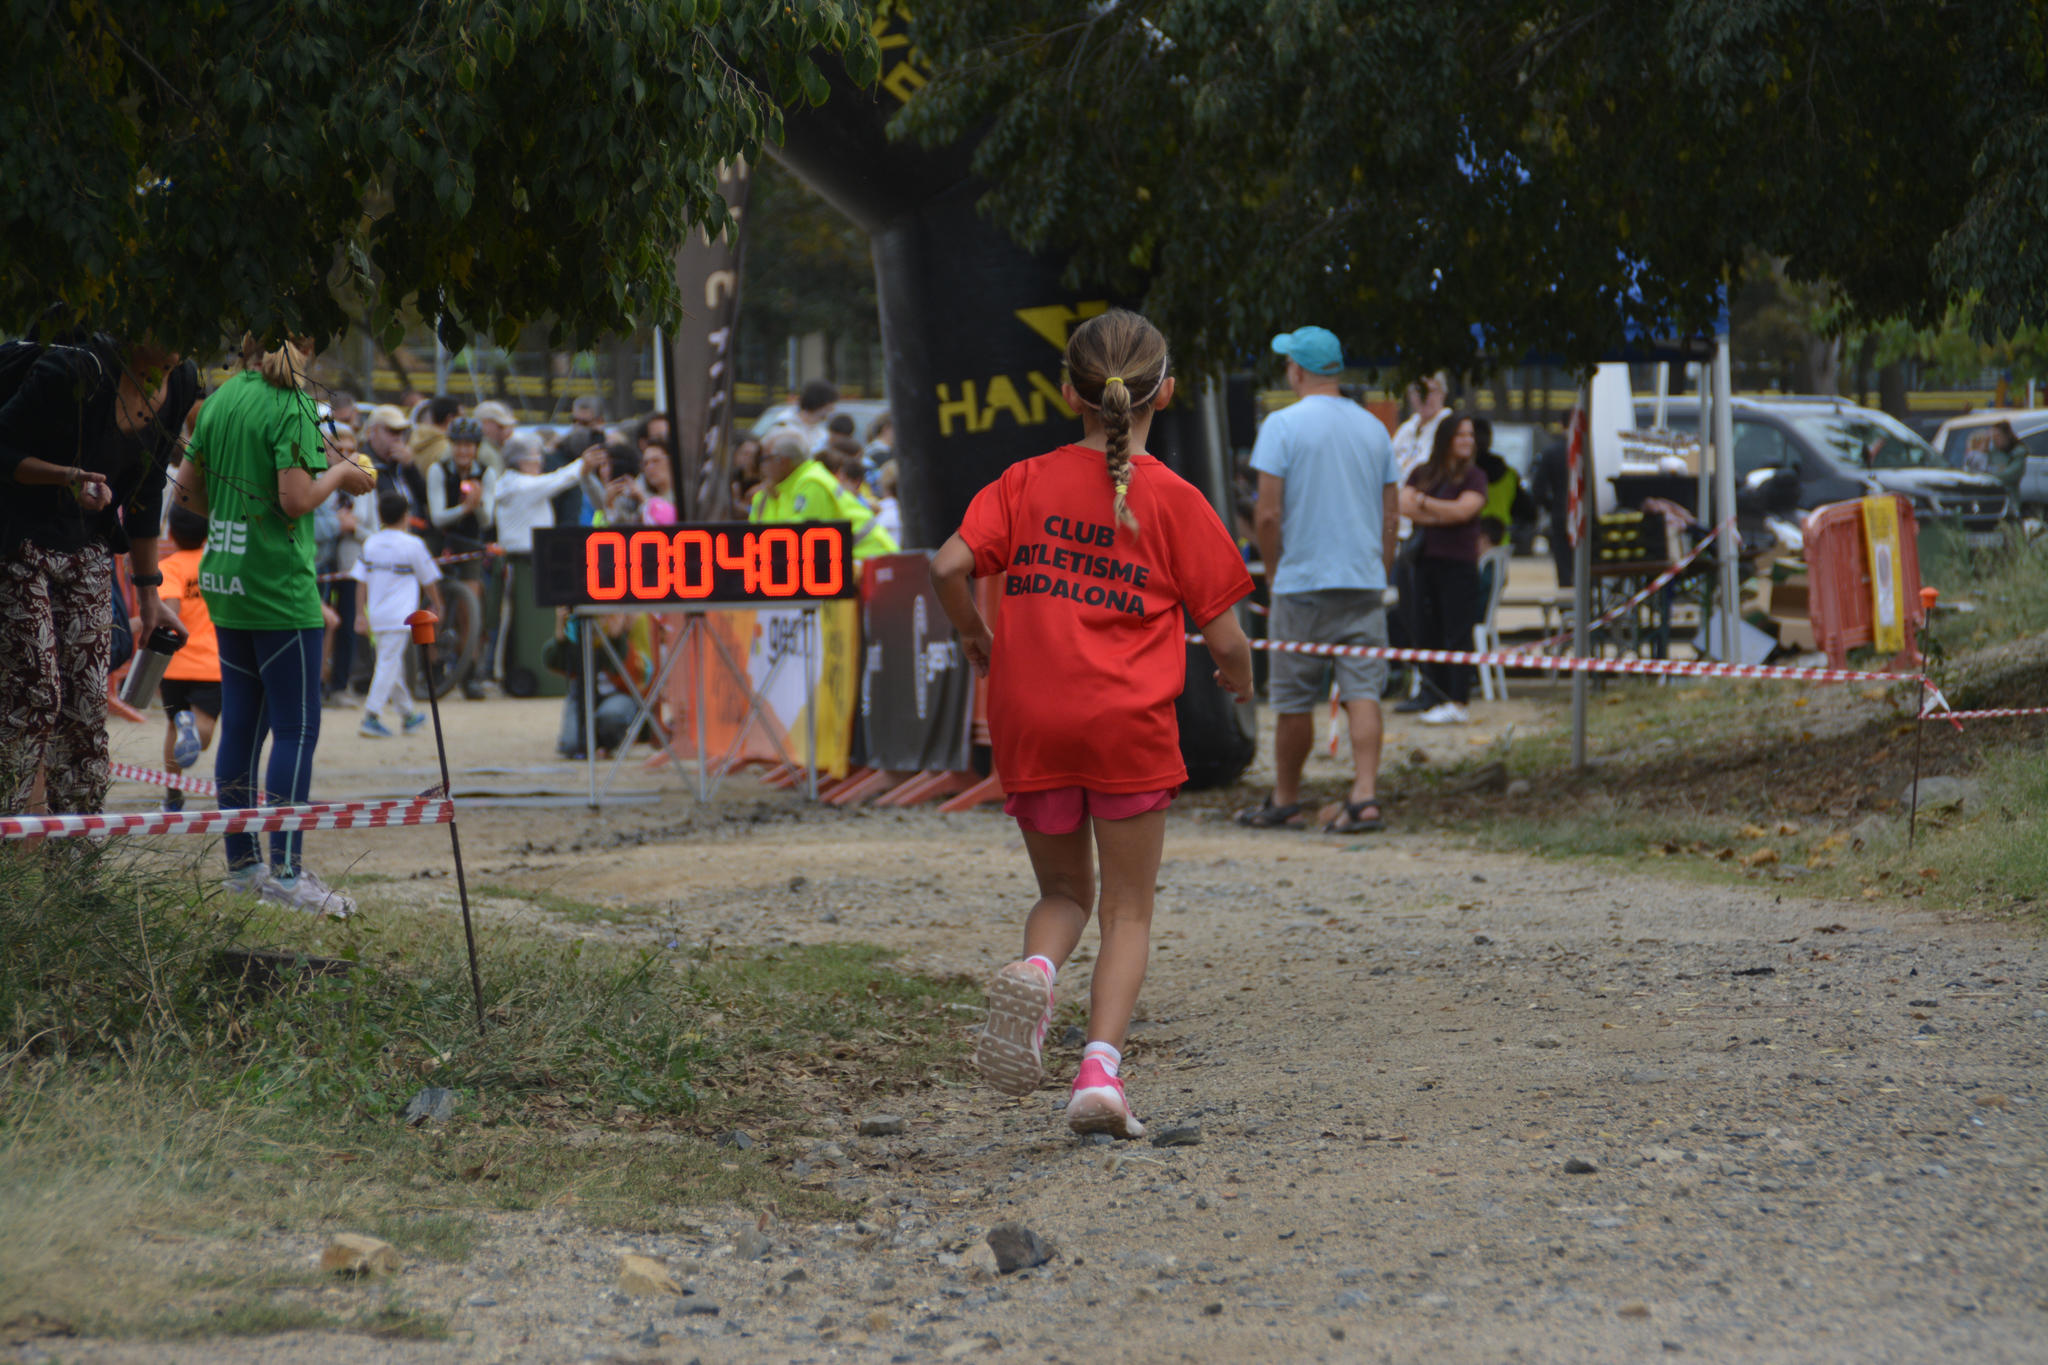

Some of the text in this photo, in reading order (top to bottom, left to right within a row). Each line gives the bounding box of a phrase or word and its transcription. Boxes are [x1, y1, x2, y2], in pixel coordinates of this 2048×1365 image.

[1043, 515, 1115, 548] CLUB
[586, 527, 843, 600] 00:04:00
[1012, 543, 1150, 589] ATLETISME
[1005, 573, 1145, 617] BADALONA
